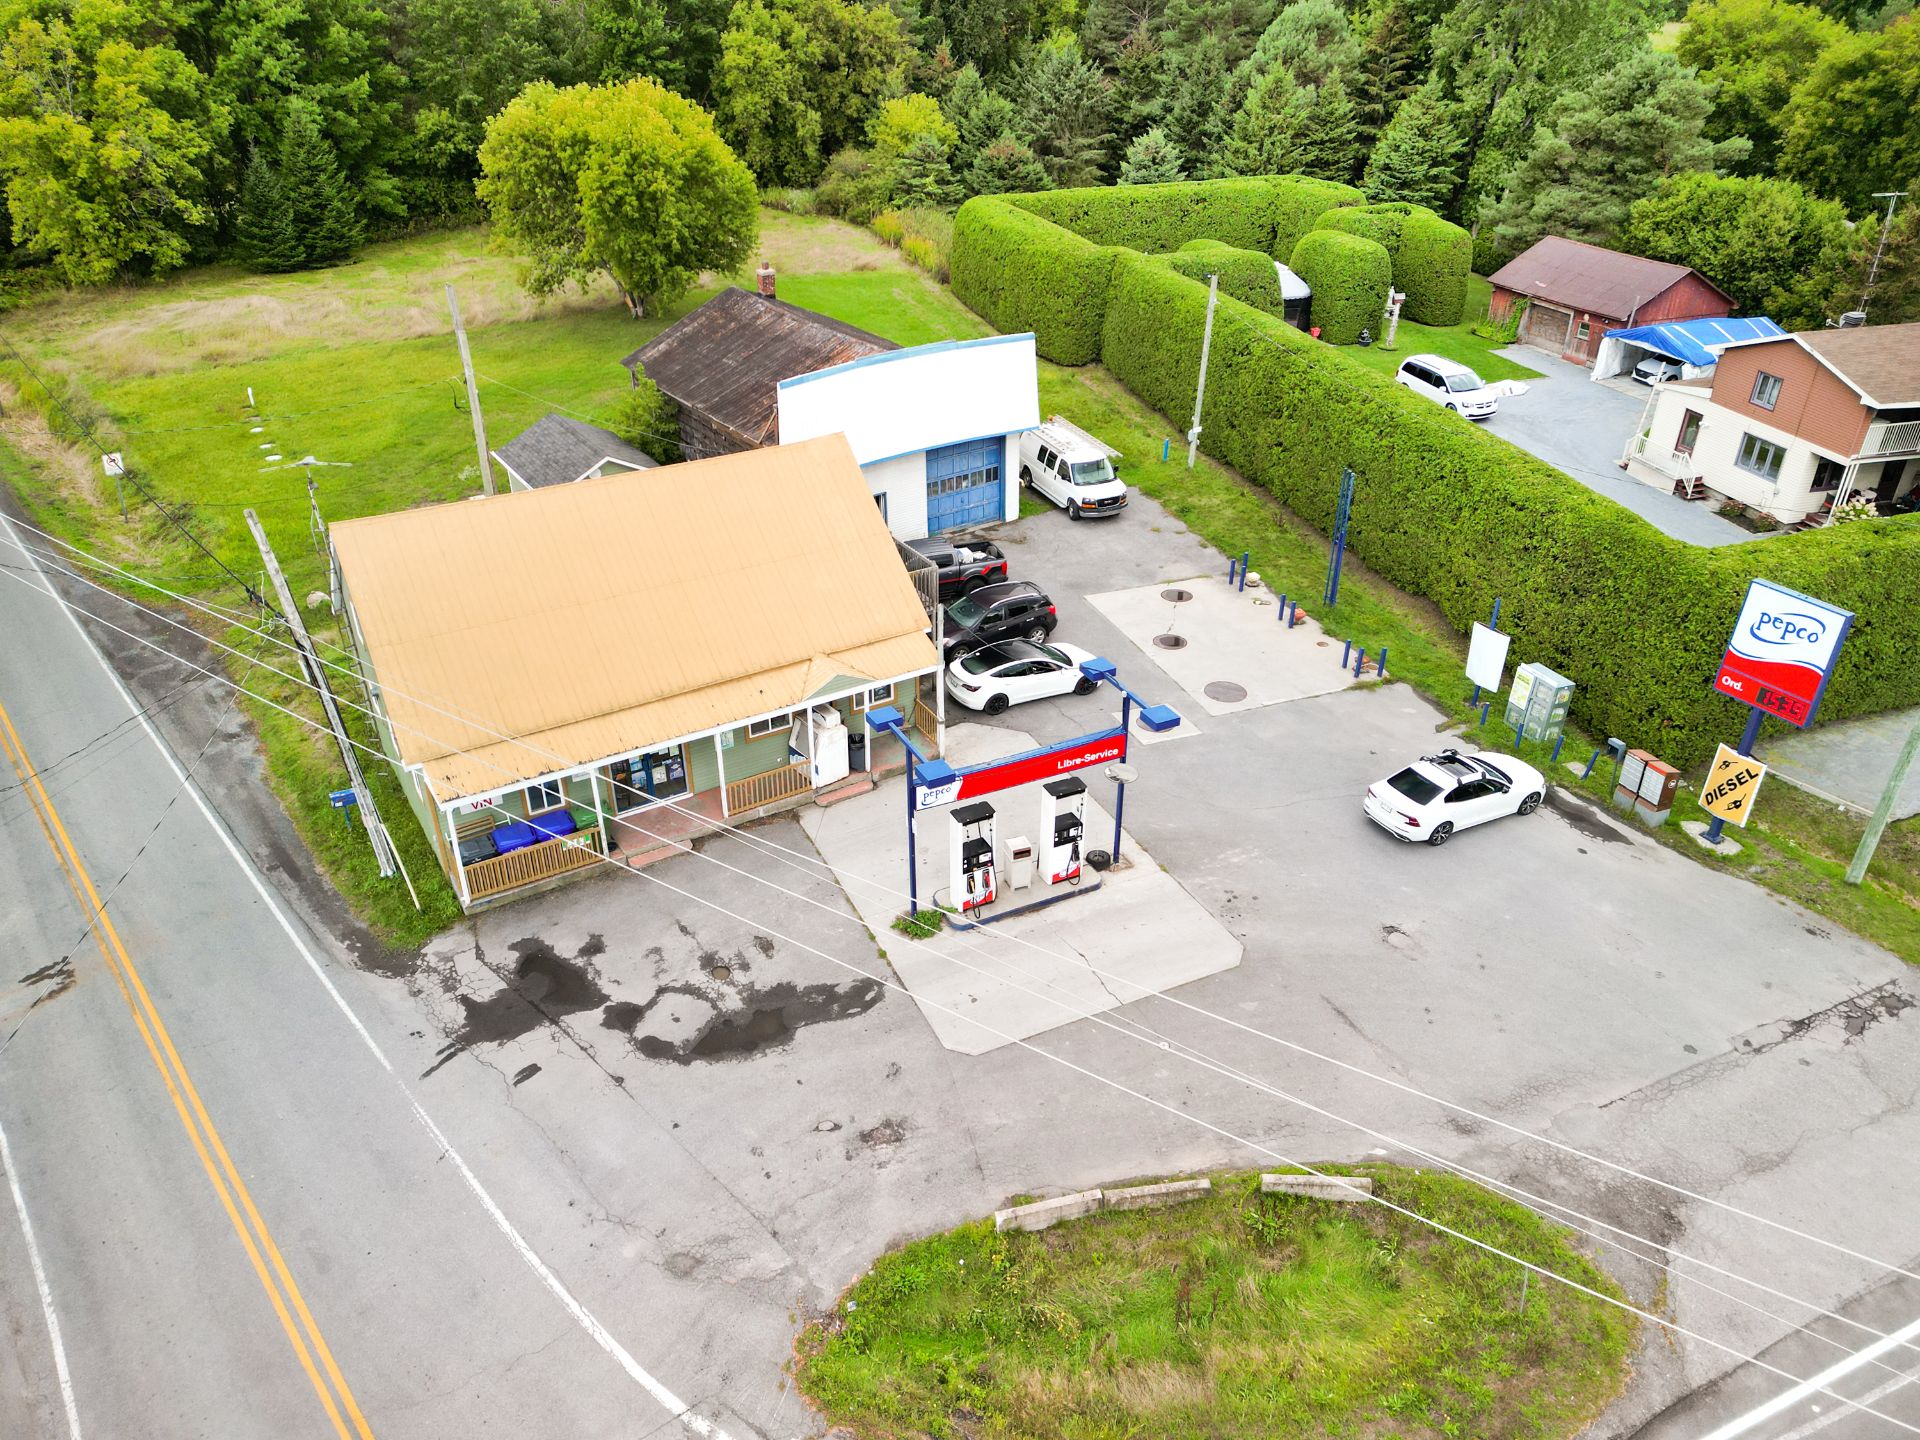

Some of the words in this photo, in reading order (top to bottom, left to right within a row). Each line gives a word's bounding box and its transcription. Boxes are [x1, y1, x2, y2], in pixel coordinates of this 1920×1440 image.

[1755, 612, 1819, 643] pepco
[1721, 675, 1743, 692] Ord.
[1057, 748, 1119, 770] Libre-Service
[922, 786, 952, 803] pepco
[1705, 768, 1759, 806] DIESEL
